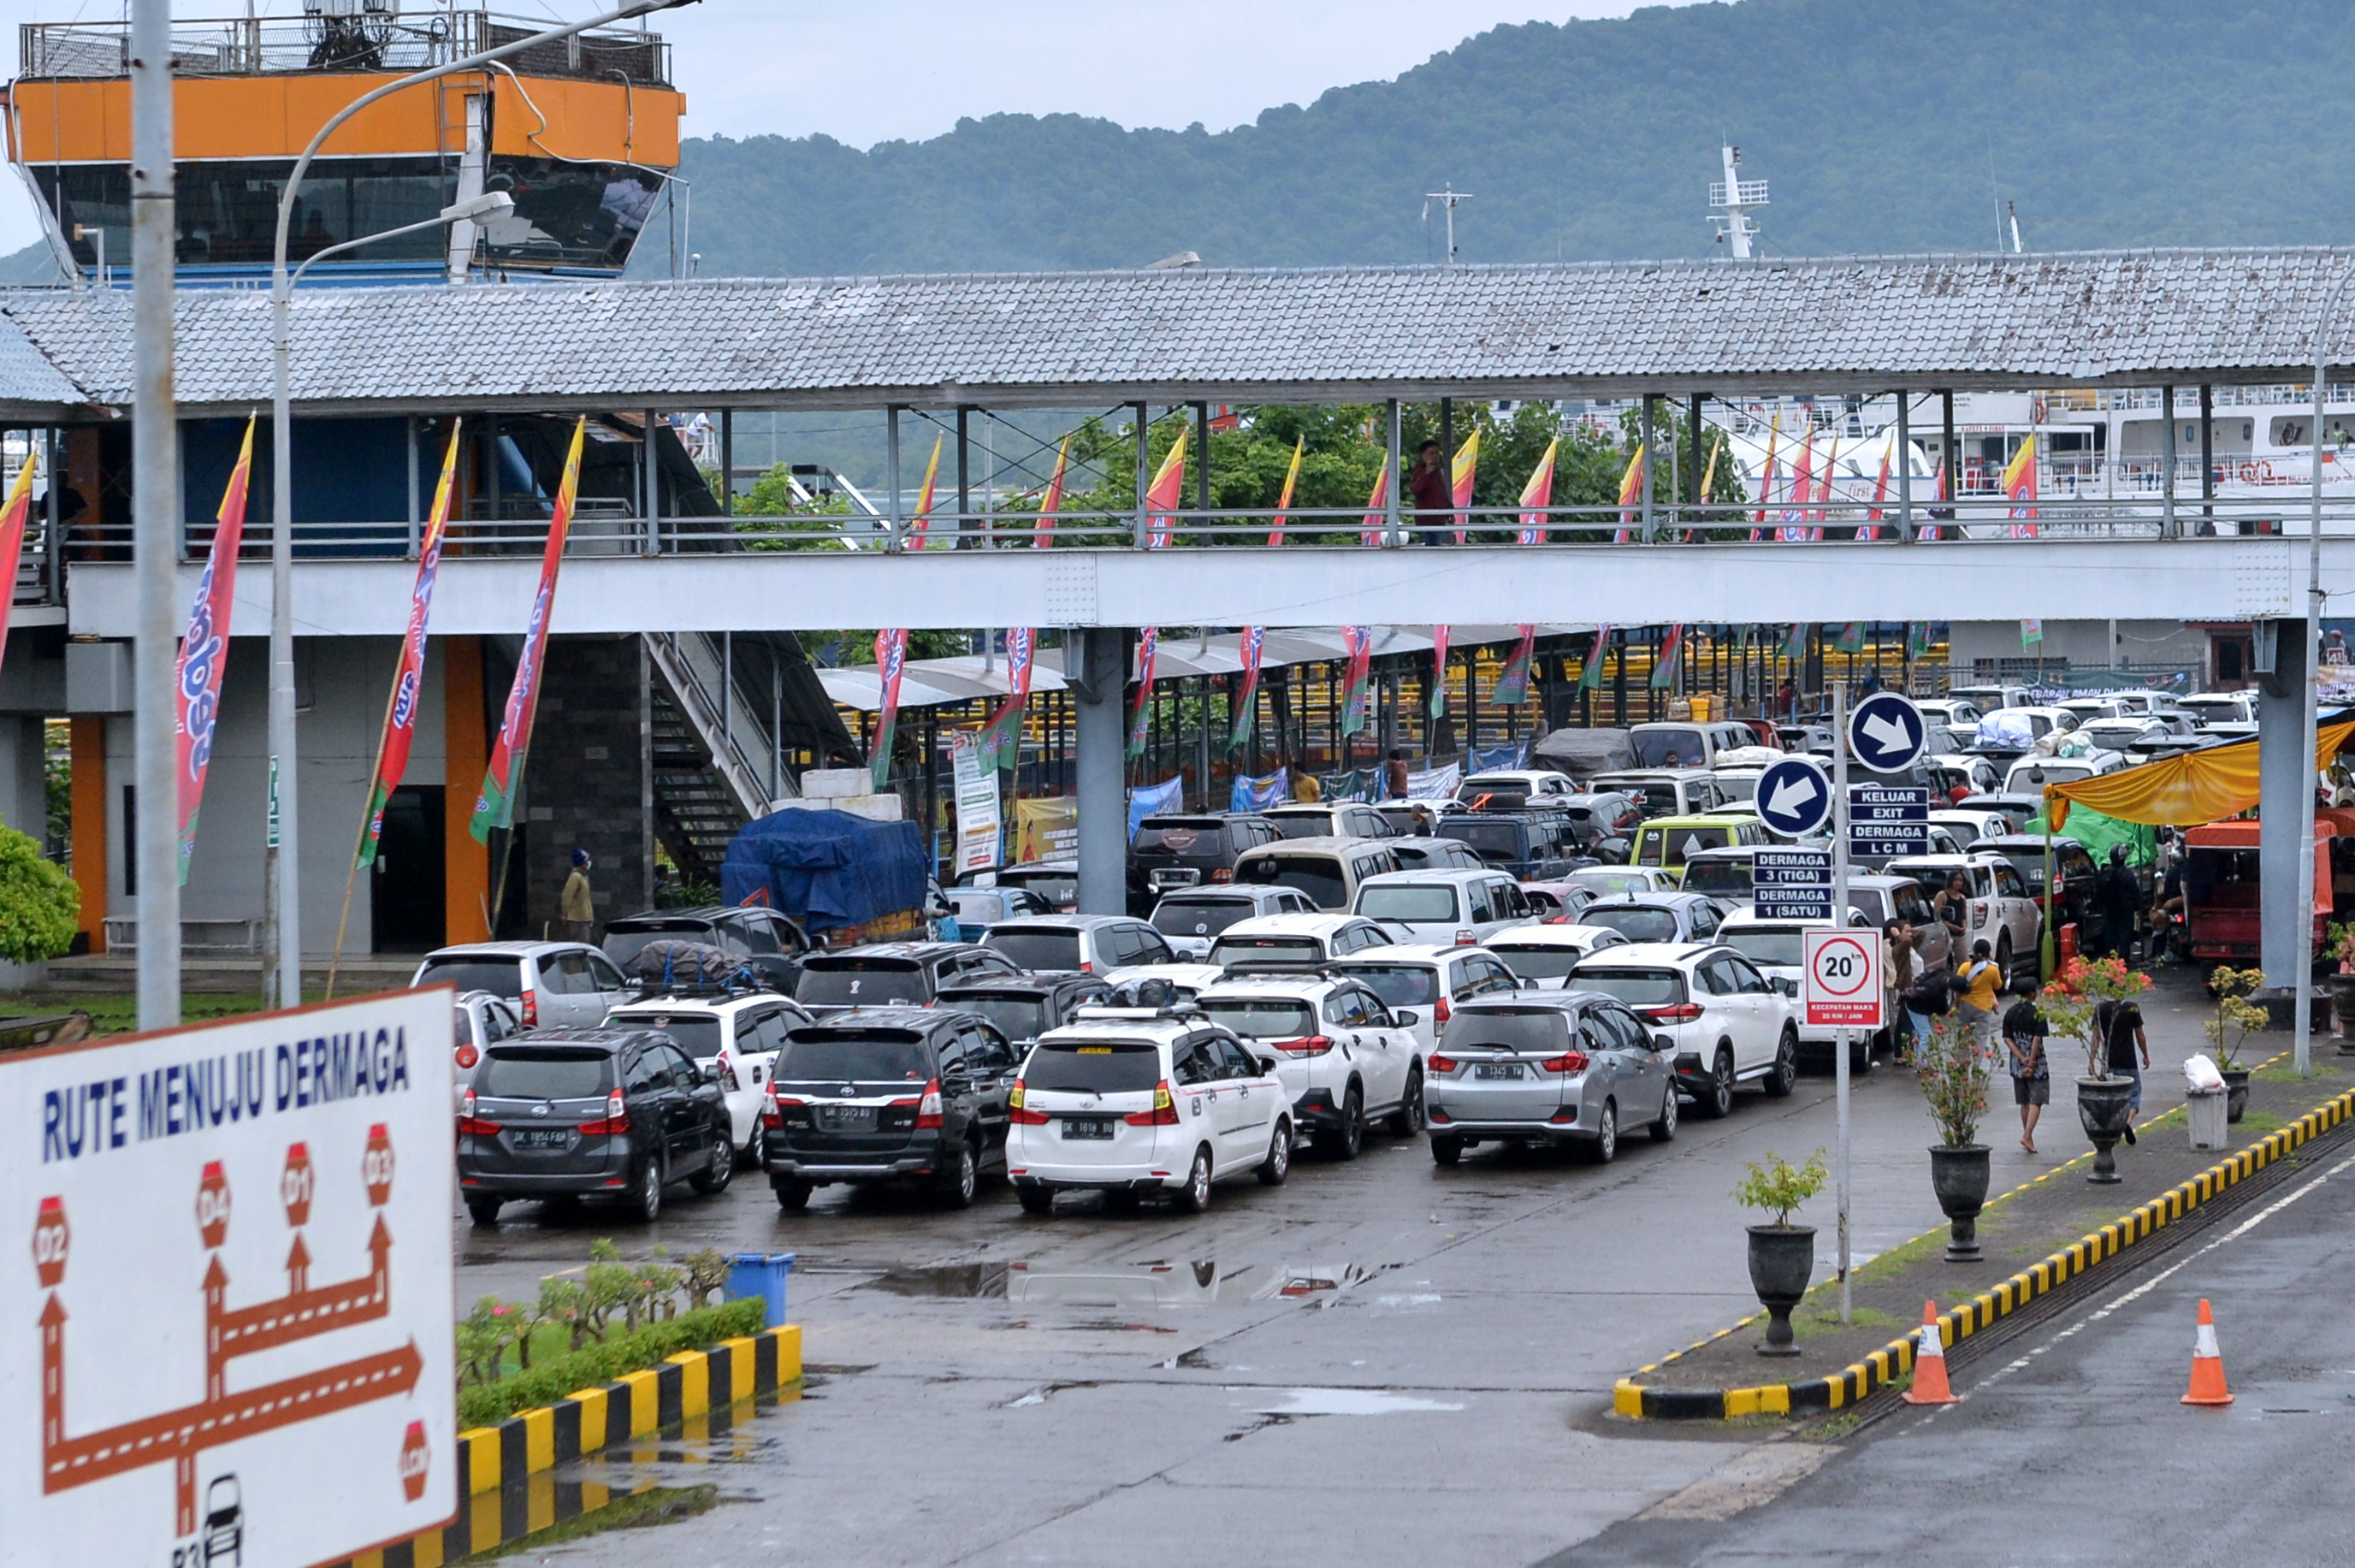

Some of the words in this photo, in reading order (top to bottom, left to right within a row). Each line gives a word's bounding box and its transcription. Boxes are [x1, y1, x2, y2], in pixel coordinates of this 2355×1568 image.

[1861, 791, 1916, 802] KELUAR
[1873, 808, 1904, 818] EXIT
[1855, 826, 1922, 837] DERMAGA
[1871, 843, 1879, 854] L
[1883, 843, 1892, 854] C
[1896, 843, 1908, 854] M
[1759, 855, 1825, 866] DERMAGA
[1766, 871, 1774, 881] 3
[1778, 870, 1820, 883] (TIGA)
[1759, 891, 1825, 901] DERMAGA
[1765, 906, 1772, 916] 1
[1777, 905, 1821, 918] (SATU)
[1825, 956, 1852, 977] 20
[1476, 1066, 1482, 1075] N
[43, 1076, 127, 1163] RUTE
[138, 1047, 266, 1142] MENUJU
[275, 1026, 410, 1113] DERMAGA
[1062, 1123, 1073, 1132] DK
[366, 1151, 393, 1185] D3
[284, 1167, 311, 1206] D1
[201, 1189, 229, 1227] D4
[36, 1224, 68, 1264] D2
